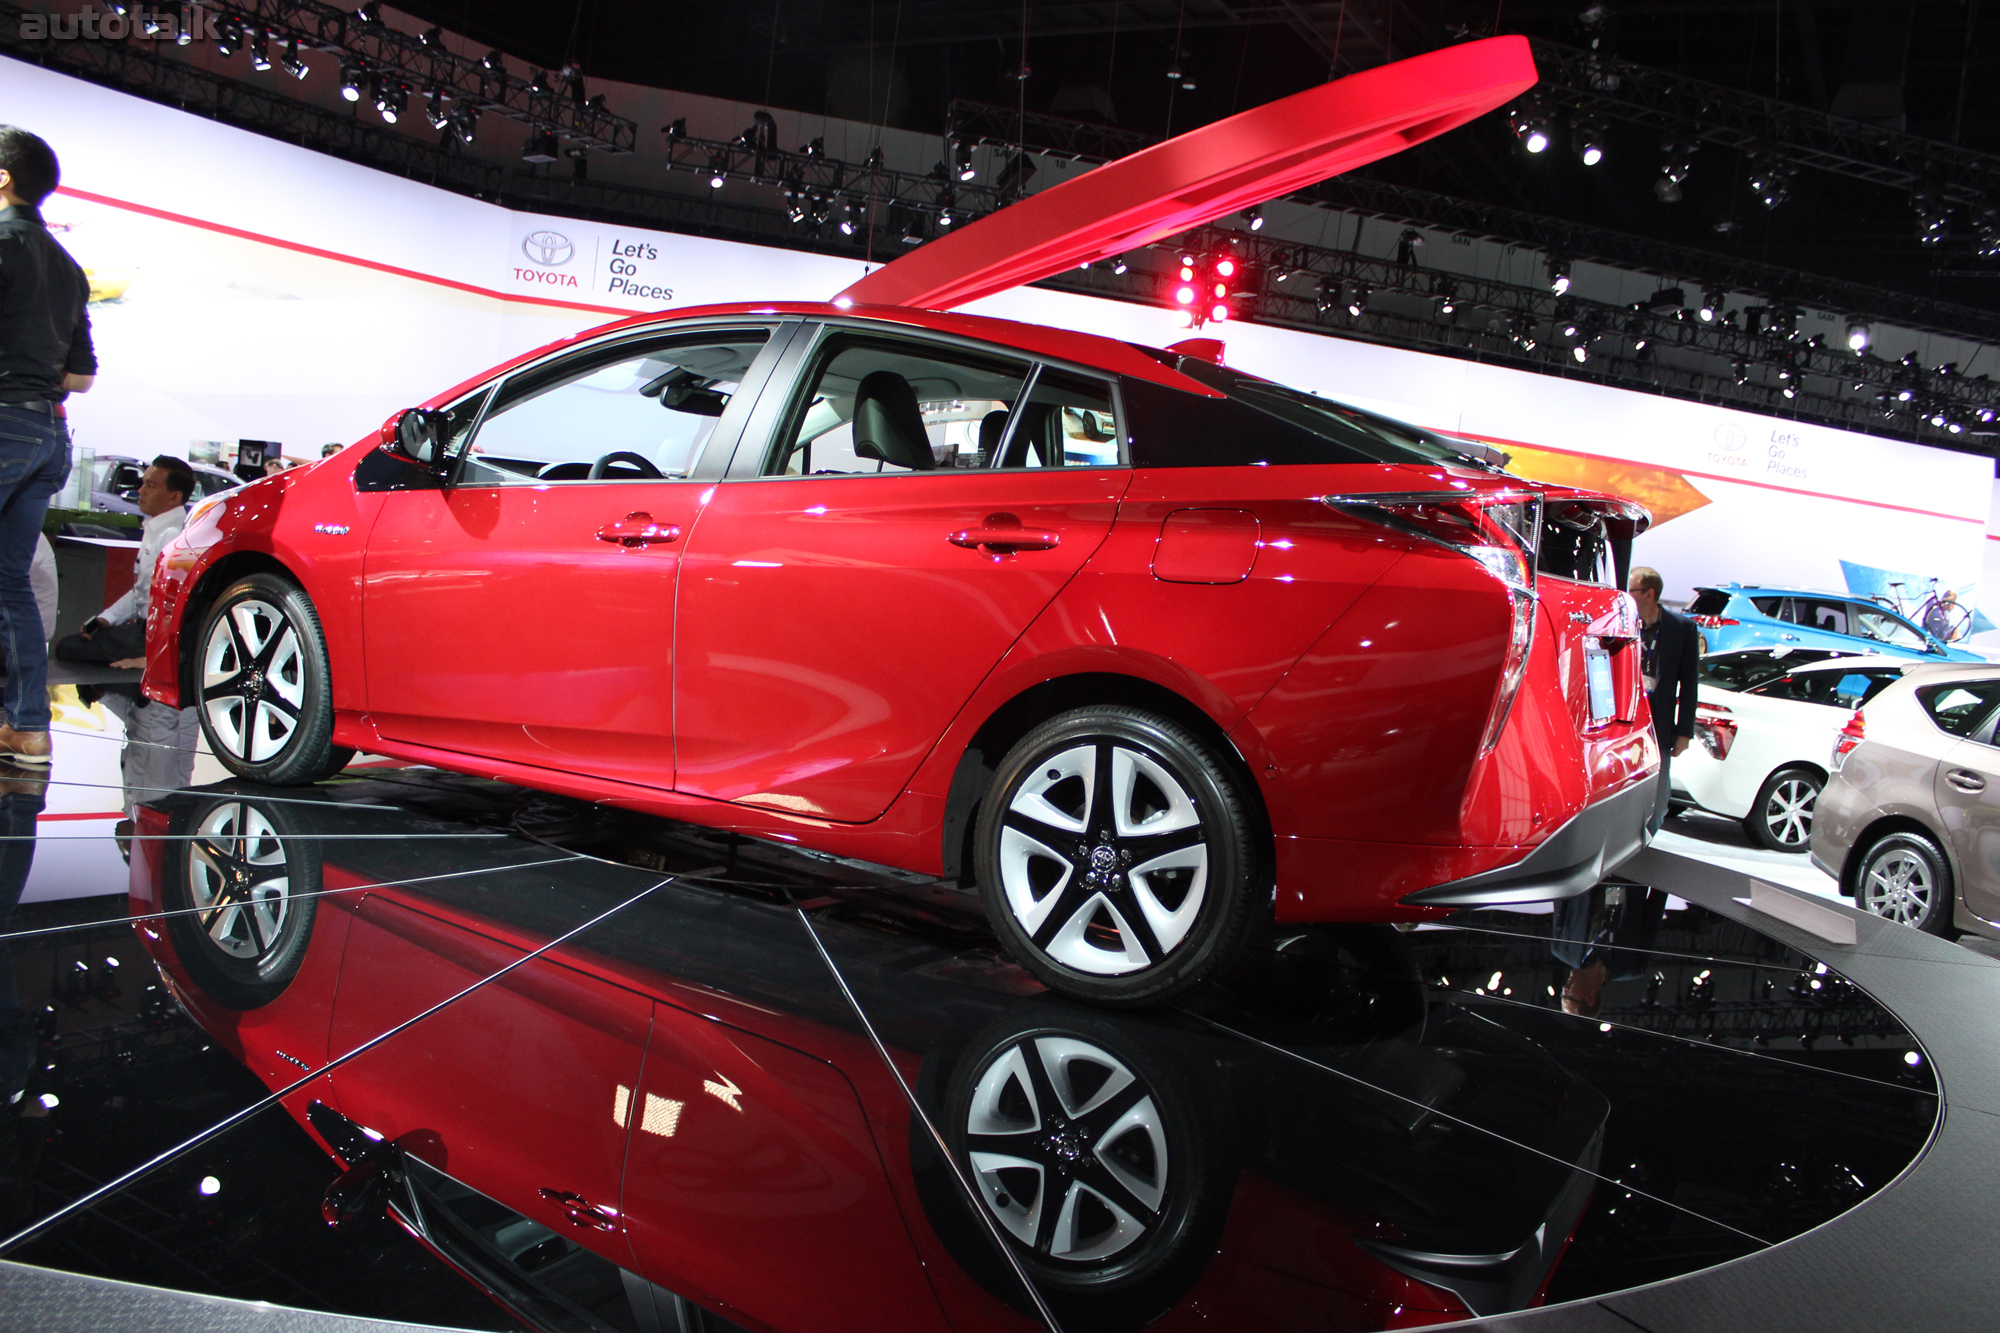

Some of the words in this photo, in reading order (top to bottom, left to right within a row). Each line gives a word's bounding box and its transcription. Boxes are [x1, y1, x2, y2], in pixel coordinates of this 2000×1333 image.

[1055, 159, 1067, 169] 18
[612, 239, 658, 260] Let's
[609, 258, 637, 276] Go
[513, 268, 578, 288] TOYOTA
[608, 277, 674, 301] Places
[1770, 430, 1800, 447] Let's
[1707, 452, 1748, 467] TOYOTA
[1768, 445, 1786, 459] Go
[1766, 460, 1808, 479] Places
